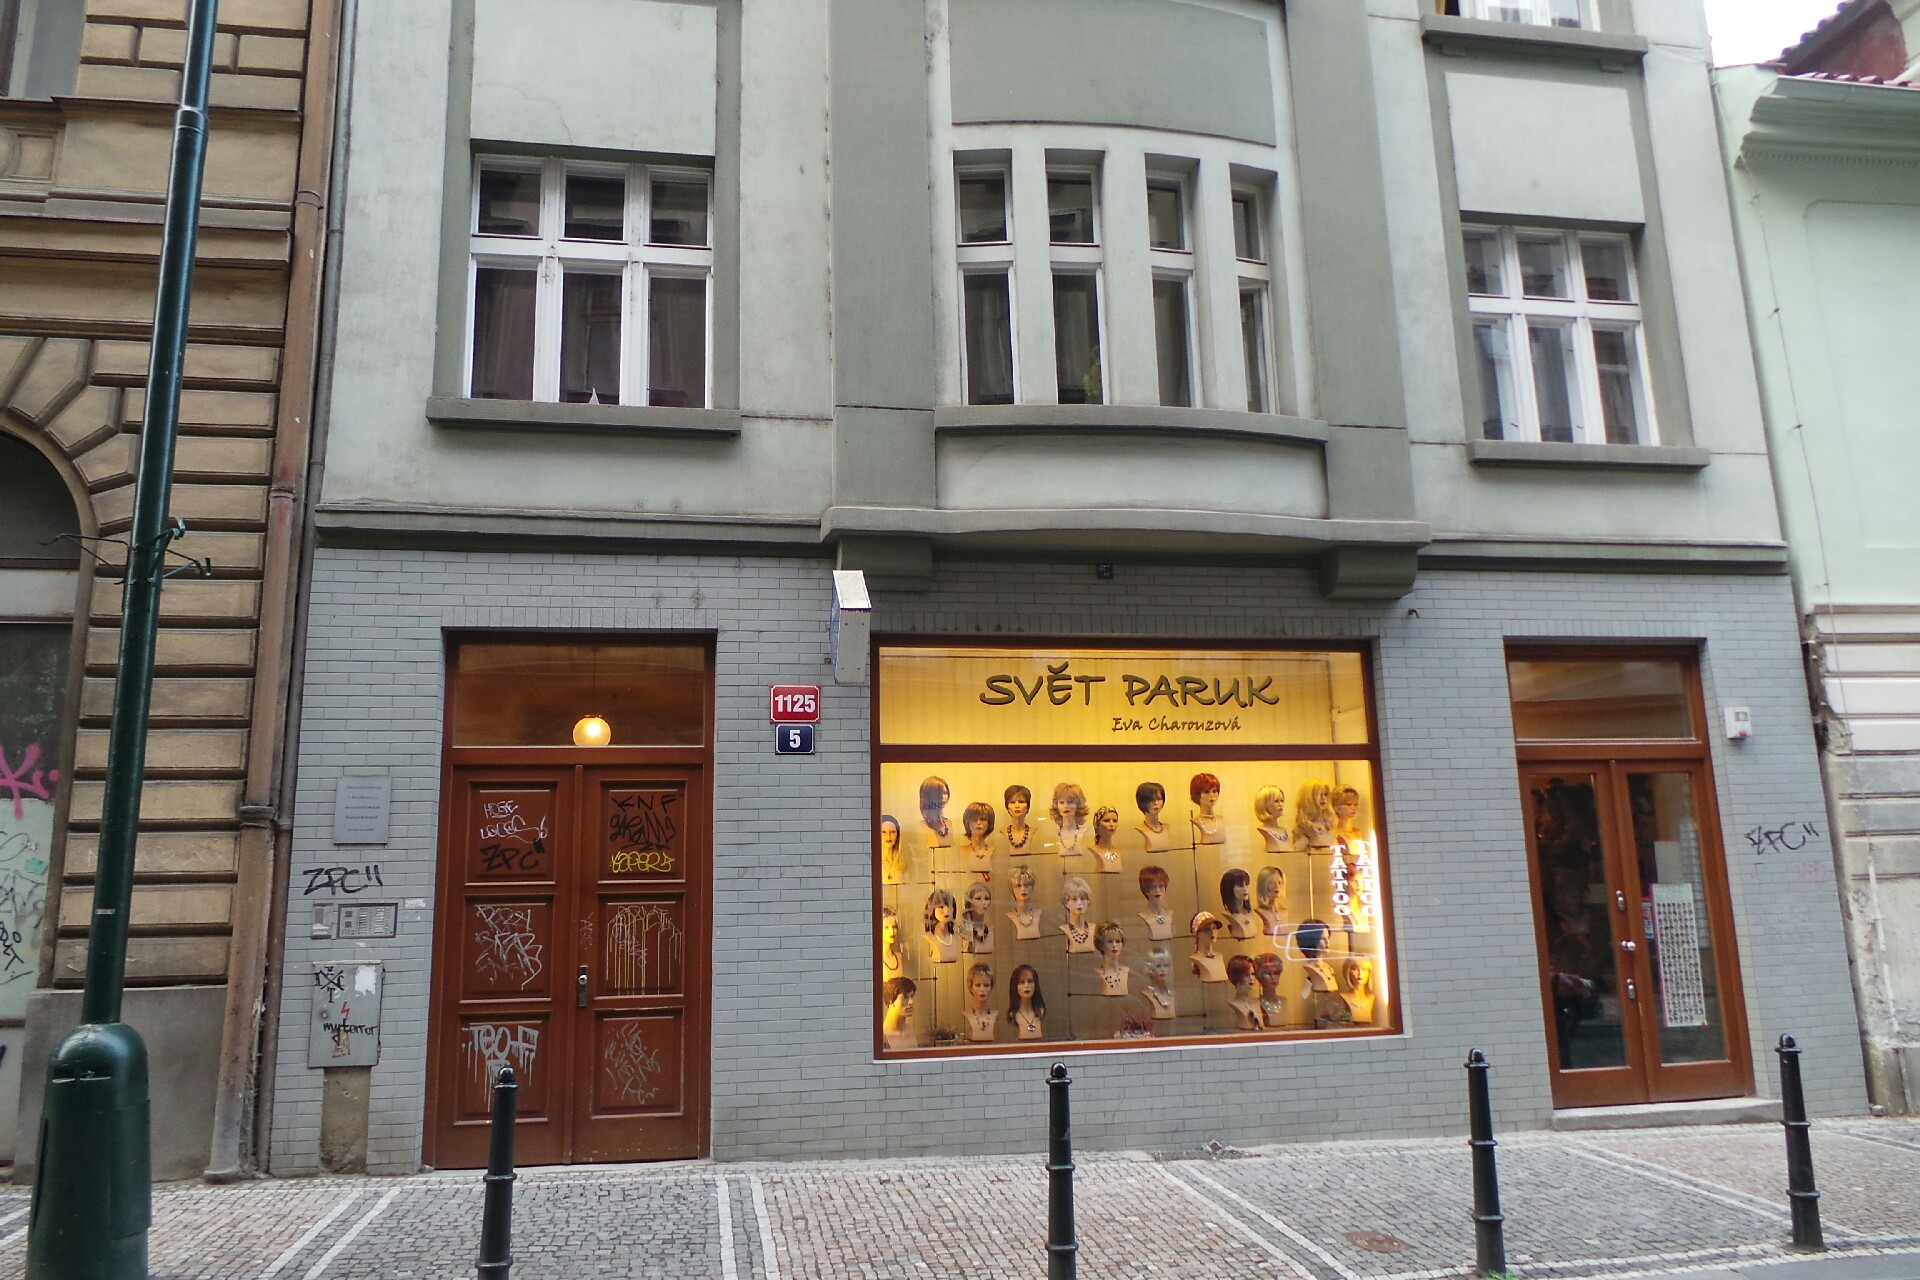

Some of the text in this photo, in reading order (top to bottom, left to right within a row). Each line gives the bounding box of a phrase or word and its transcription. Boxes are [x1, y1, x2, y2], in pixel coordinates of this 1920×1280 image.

[979, 661, 1279, 708] SVĚT PARUK
[774, 694, 816, 713] 1125
[1111, 715, 1241, 732] Eva Charouzová
[789, 729, 801, 748] 5
[1329, 844, 1351, 916] TATTOO
